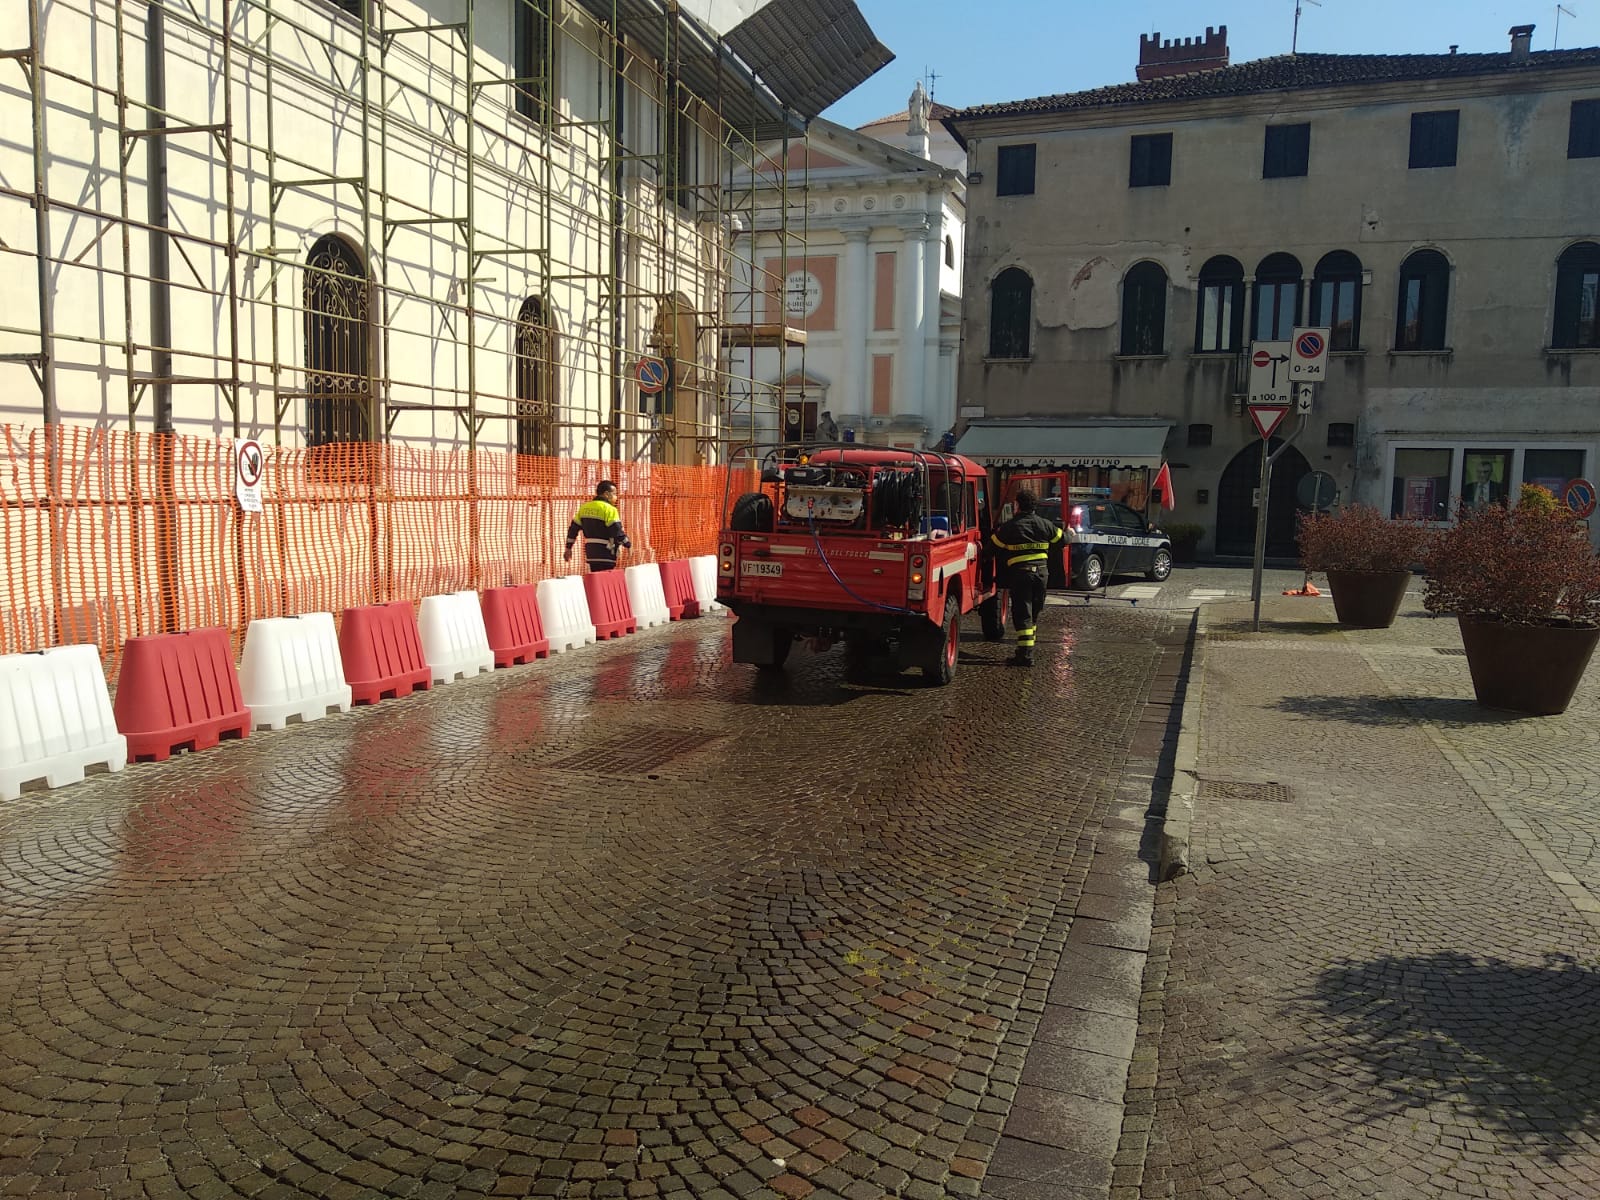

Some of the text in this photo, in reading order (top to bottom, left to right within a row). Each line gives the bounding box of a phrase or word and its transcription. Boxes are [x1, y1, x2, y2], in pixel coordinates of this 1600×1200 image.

[1260, 393, 1276, 401] 100
[1107, 535, 1127, 544] POLIZIA
[1131, 536, 1150, 546] LOCALE
[756, 563, 781, 575] 19349
